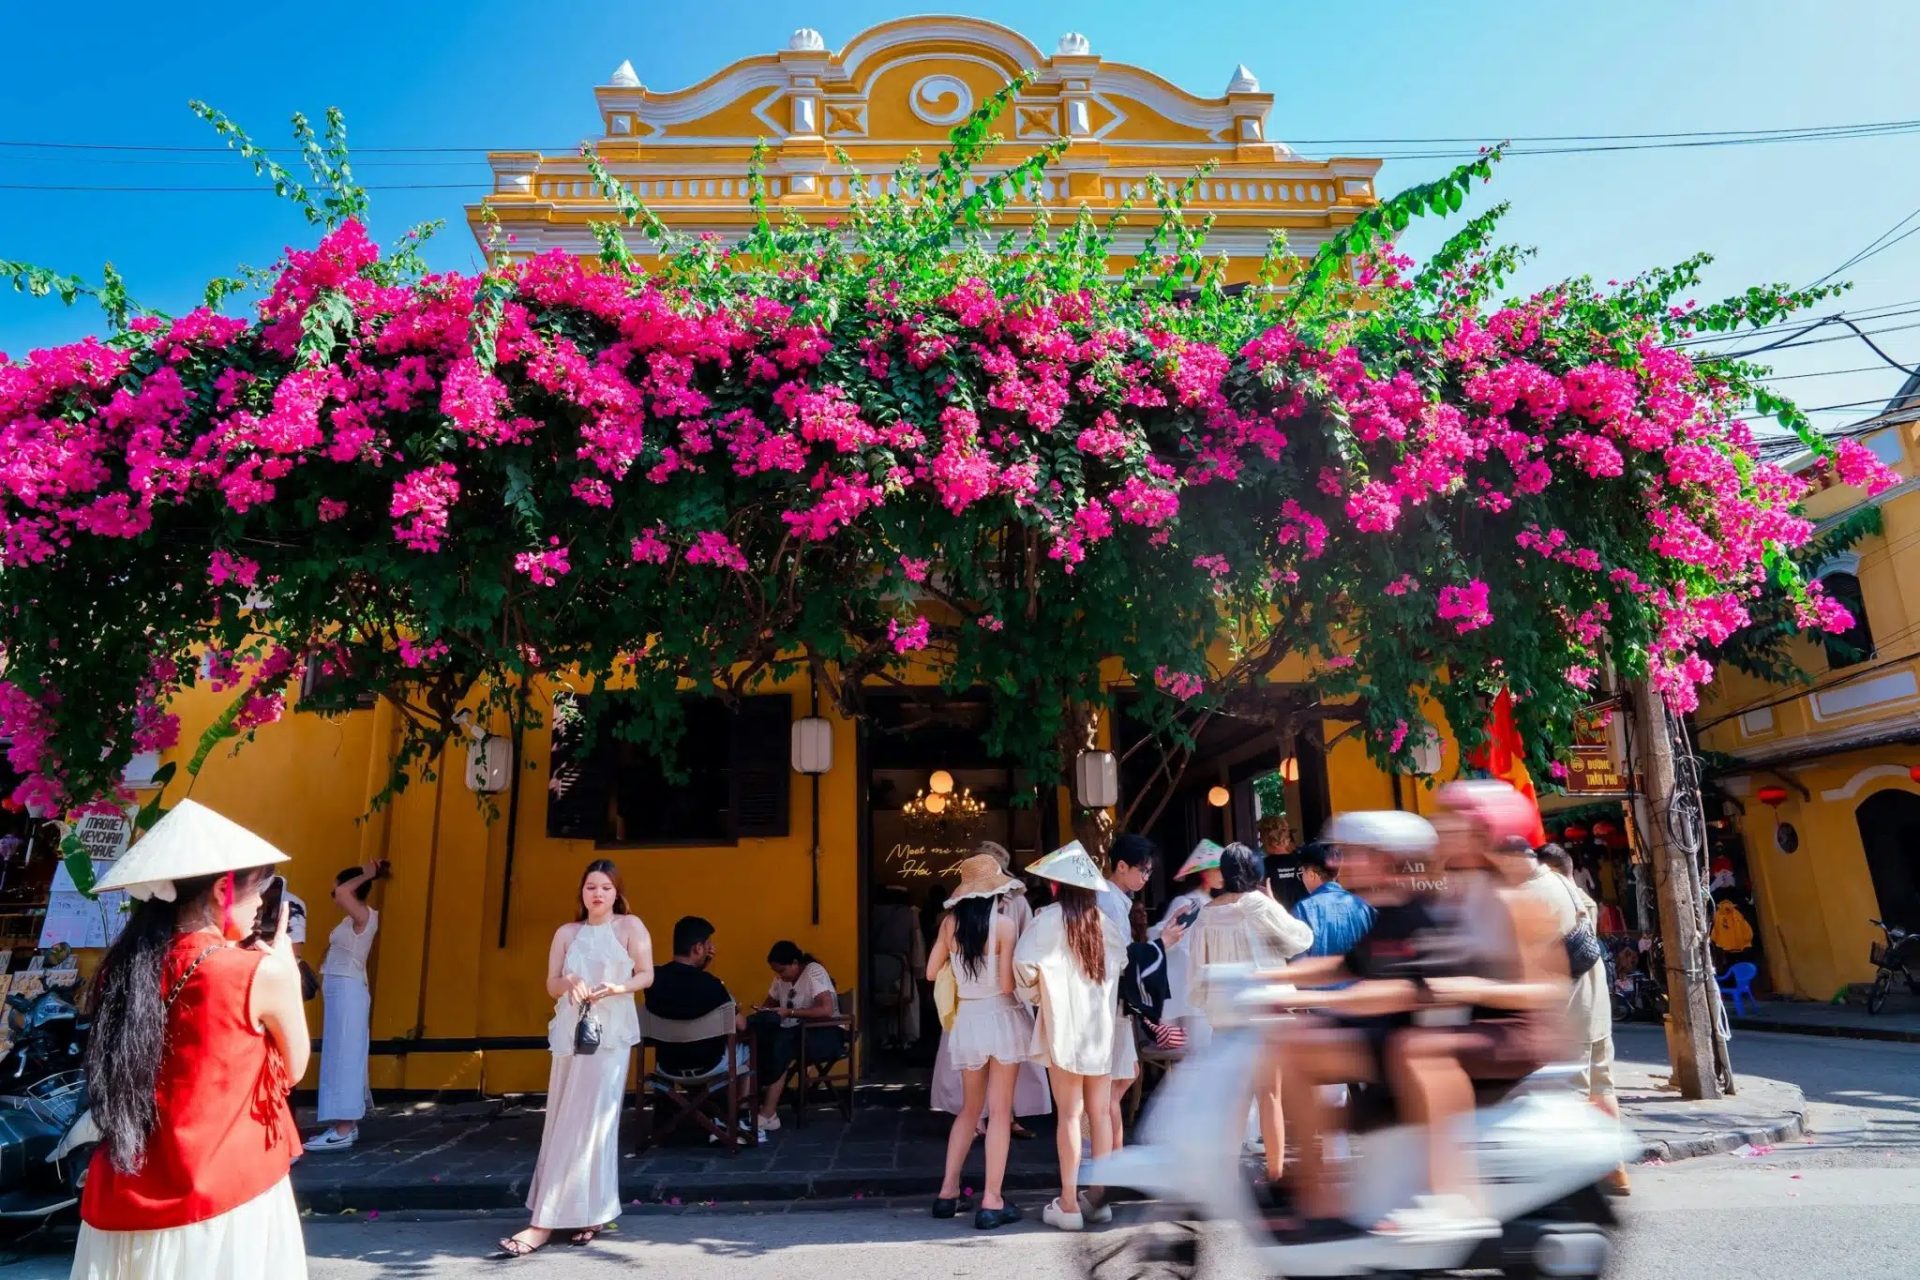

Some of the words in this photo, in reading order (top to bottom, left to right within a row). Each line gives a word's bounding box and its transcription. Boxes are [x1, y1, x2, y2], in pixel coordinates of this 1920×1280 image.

[85, 817, 125, 831] MAGNET
[80, 830, 124, 845] KEYCHAIN
[938, 860, 963, 877] A
[1402, 860, 1425, 873] An
[1410, 876, 1448, 891] love!
